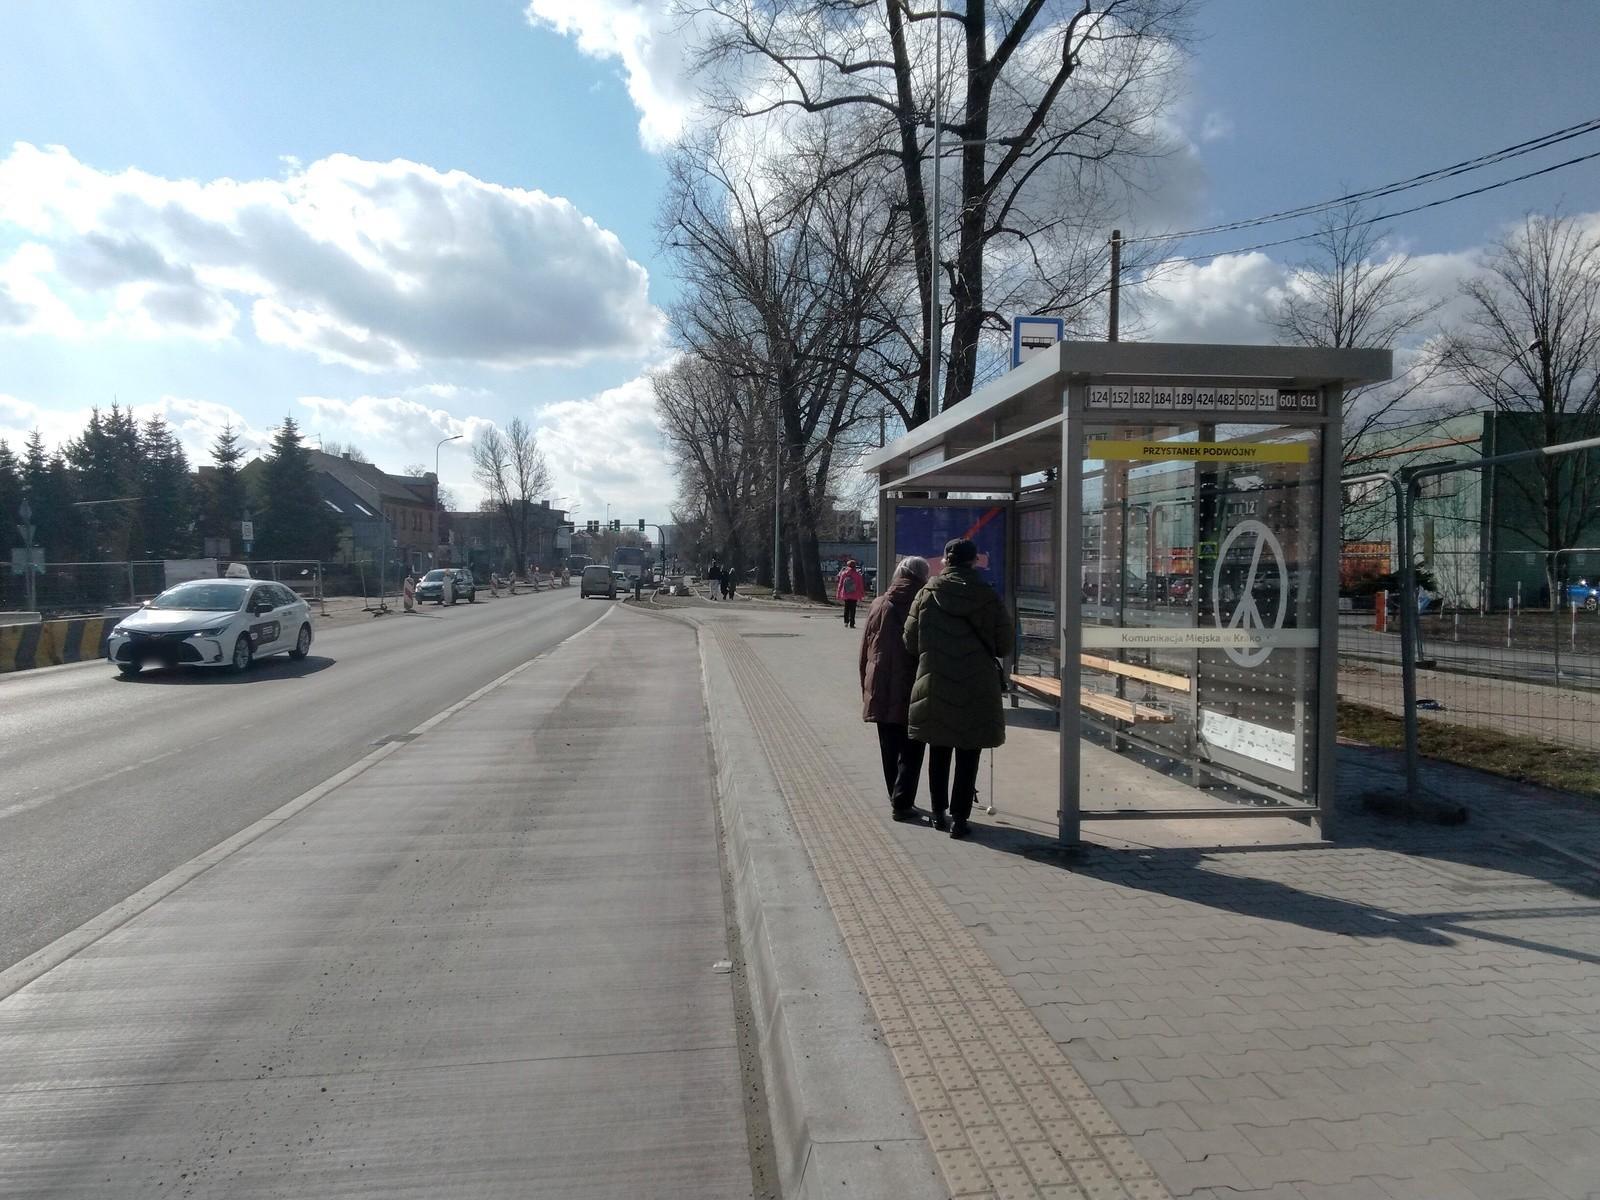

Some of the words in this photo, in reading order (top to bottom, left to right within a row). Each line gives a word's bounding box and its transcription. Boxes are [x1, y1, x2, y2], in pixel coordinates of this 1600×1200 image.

[1091, 392, 1108, 403] 124
[1113, 392, 1129, 404] 152
[1134, 392, 1150, 404] 182
[1155, 393, 1171, 404] 184
[1176, 393, 1193, 405] 189
[1197, 393, 1214, 405] 424
[1218, 394, 1235, 406] 482
[1239, 394, 1256, 406] 502
[1259, 395, 1275, 407] 511
[1280, 395, 1297, 407] 601
[1301, 395, 1317, 407] 611
[1143, 446, 1201, 456] PRZYSTANEK
[1203, 446, 1257, 457] PODWÓJNY
[1121, 633, 1184, 645] Komunikacja
[1185, 633, 1221, 645] Miejska
